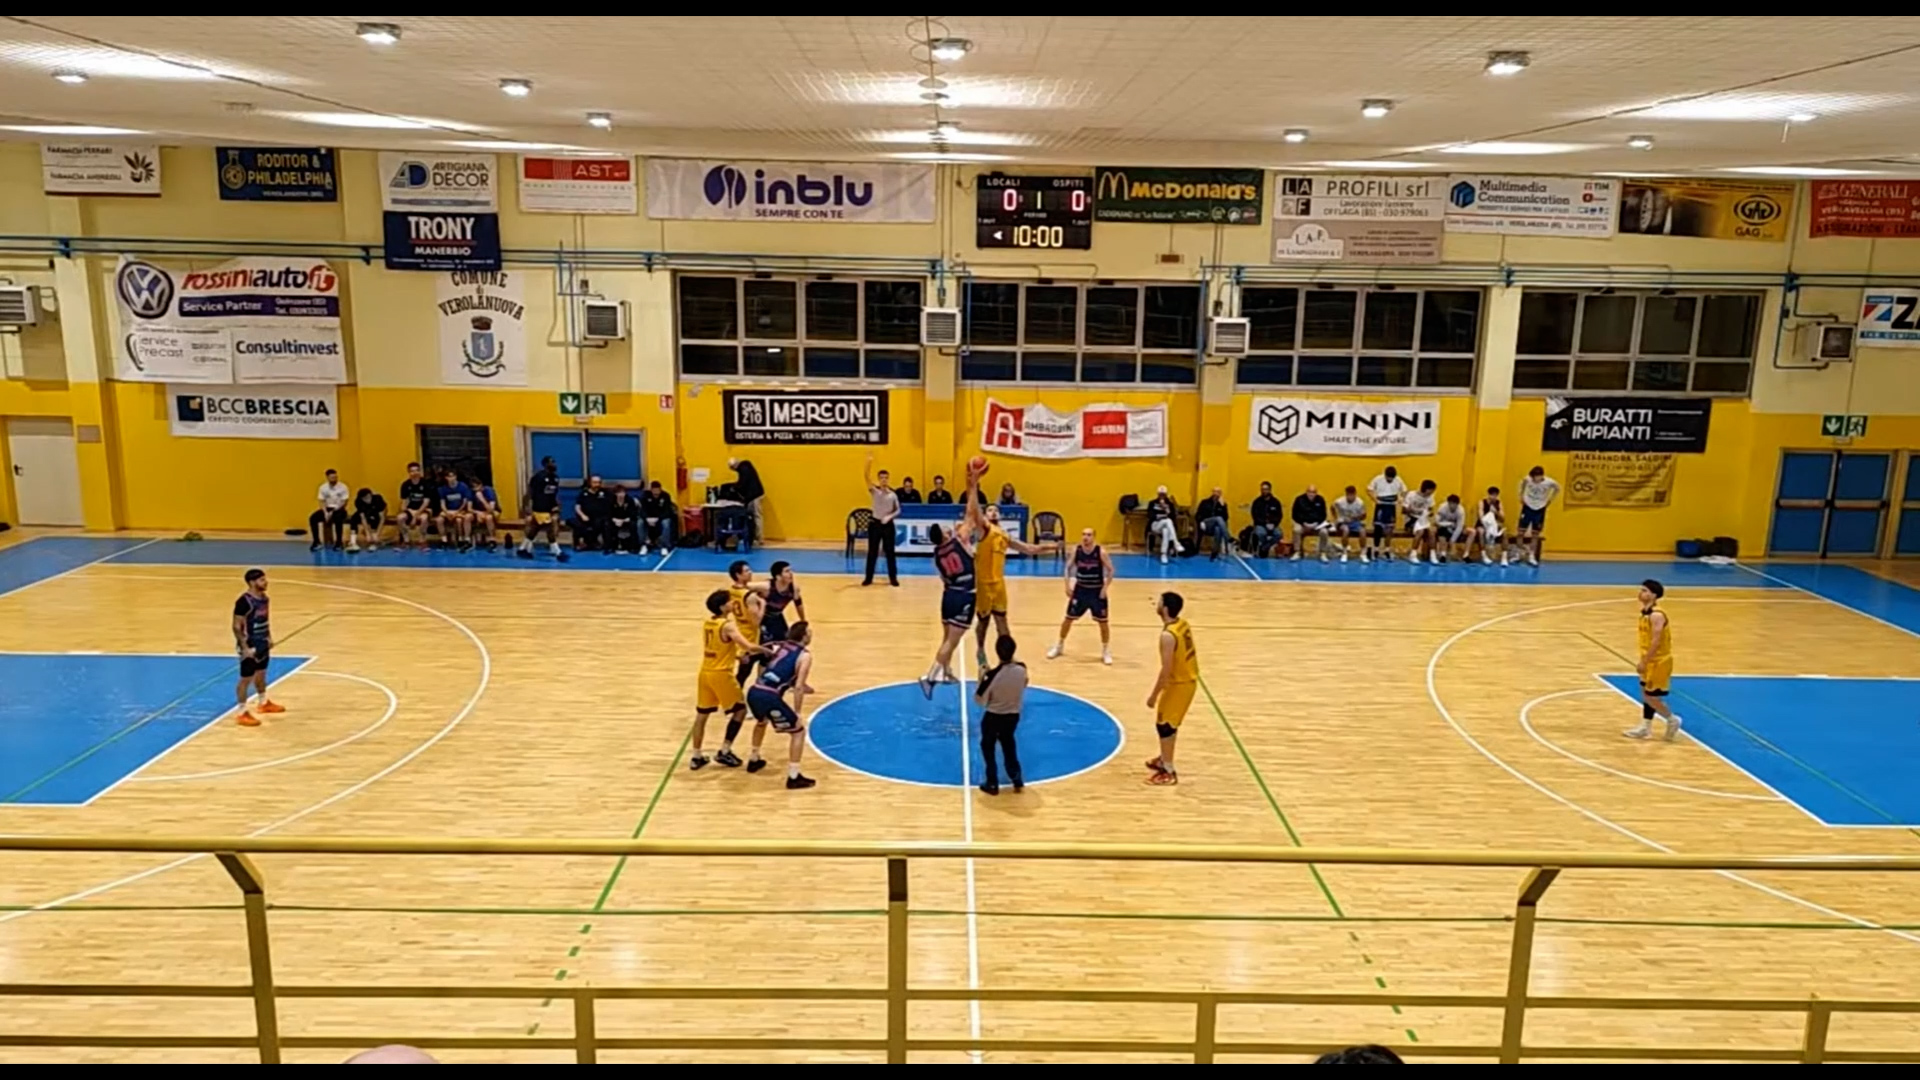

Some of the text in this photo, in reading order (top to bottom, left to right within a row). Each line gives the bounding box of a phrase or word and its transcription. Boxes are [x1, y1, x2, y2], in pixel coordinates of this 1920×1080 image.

[257, 154, 309, 168] RODITOR
[432, 162, 489, 173] ARTIGIANA
[575, 164, 613, 177] AST
[247, 170, 333, 189] PHILADELPHIA
[432, 172, 489, 187] DECOR
[754, 169, 873, 206] inblu
[986, 178, 1021, 187] LOCALI
[1052, 179, 1085, 188] OSPITI
[1478, 180, 1548, 193] Multimedia
[1130, 181, 1258, 200] McDonald's
[1326, 181, 1430, 197] PROFILI srl
[1839, 183, 1908, 199] GENERALI
[1004, 188, 1017, 212] 0
[1071, 190, 1085, 212] 0
[1477, 192, 1571, 206] Communication
[755, 208, 844, 219] SEMPRE CON TE
[407, 216, 475, 240] TRONY
[1735, 226, 1761, 237] GAG
[1013, 225, 1064, 248] 10:00
[414, 246, 472, 256] MANERBIO
[451, 270, 509, 289] COMUNE
[182, 301, 224, 312] Service
[225, 300, 263, 311] Partner
[437, 294, 525, 321] VEROLANUOVA
[235, 338, 340, 356] Consultinvest
[773, 401, 871, 424] MARCONI
[1305, 410, 1431, 430] MININI
[1572, 408, 1653, 424] BURATTI
[1571, 425, 1651, 441] IMPIANTI
[941, 551, 965, 577] 10
